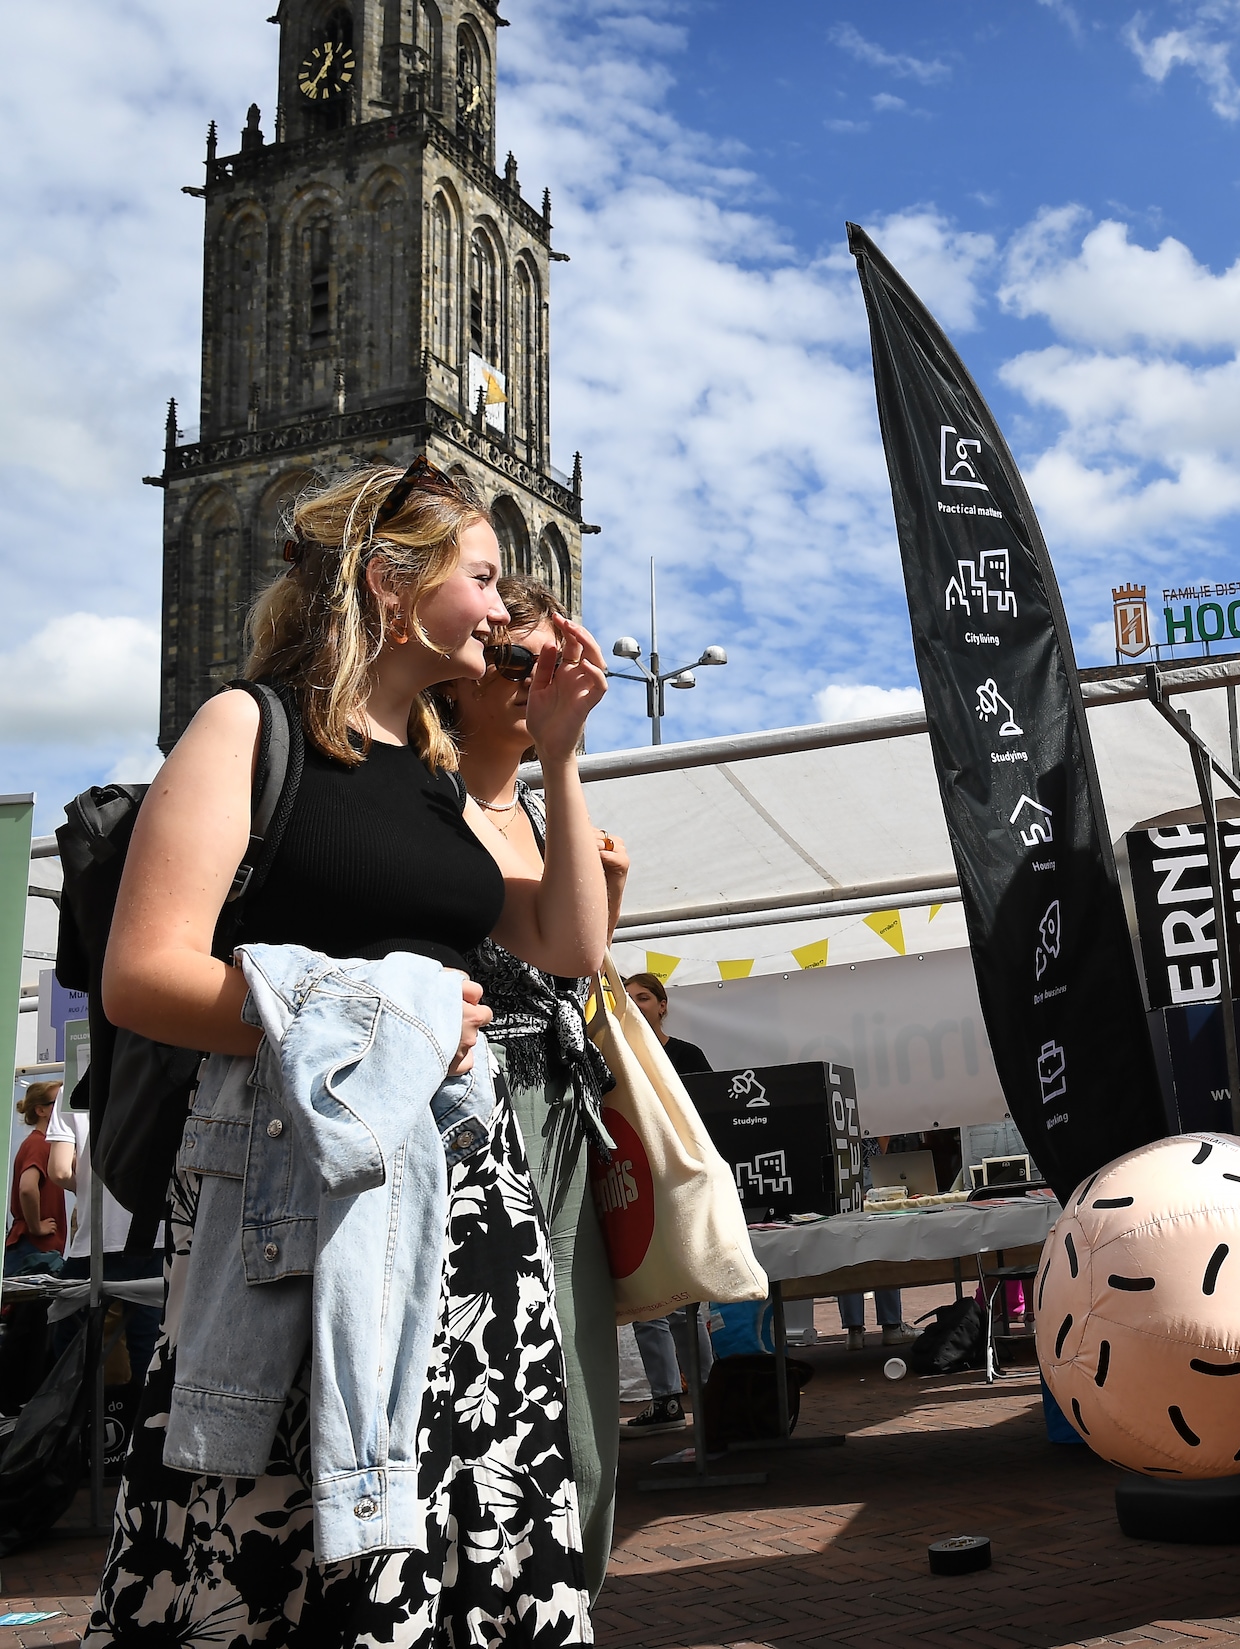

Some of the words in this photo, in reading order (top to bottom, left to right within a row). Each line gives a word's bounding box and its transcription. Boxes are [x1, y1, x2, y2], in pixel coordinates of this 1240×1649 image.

[937, 501, 976, 515] Practical
[1162, 585, 1211, 602] FAMILIE
[990, 750, 1028, 763] Studying
[1032, 859, 1056, 872] Housing
[1044, 984, 1068, 999] business
[732, 1115, 768, 1126] Studying
[1046, 1112, 1069, 1131] Working
[107, 1401, 124, 1412] do
